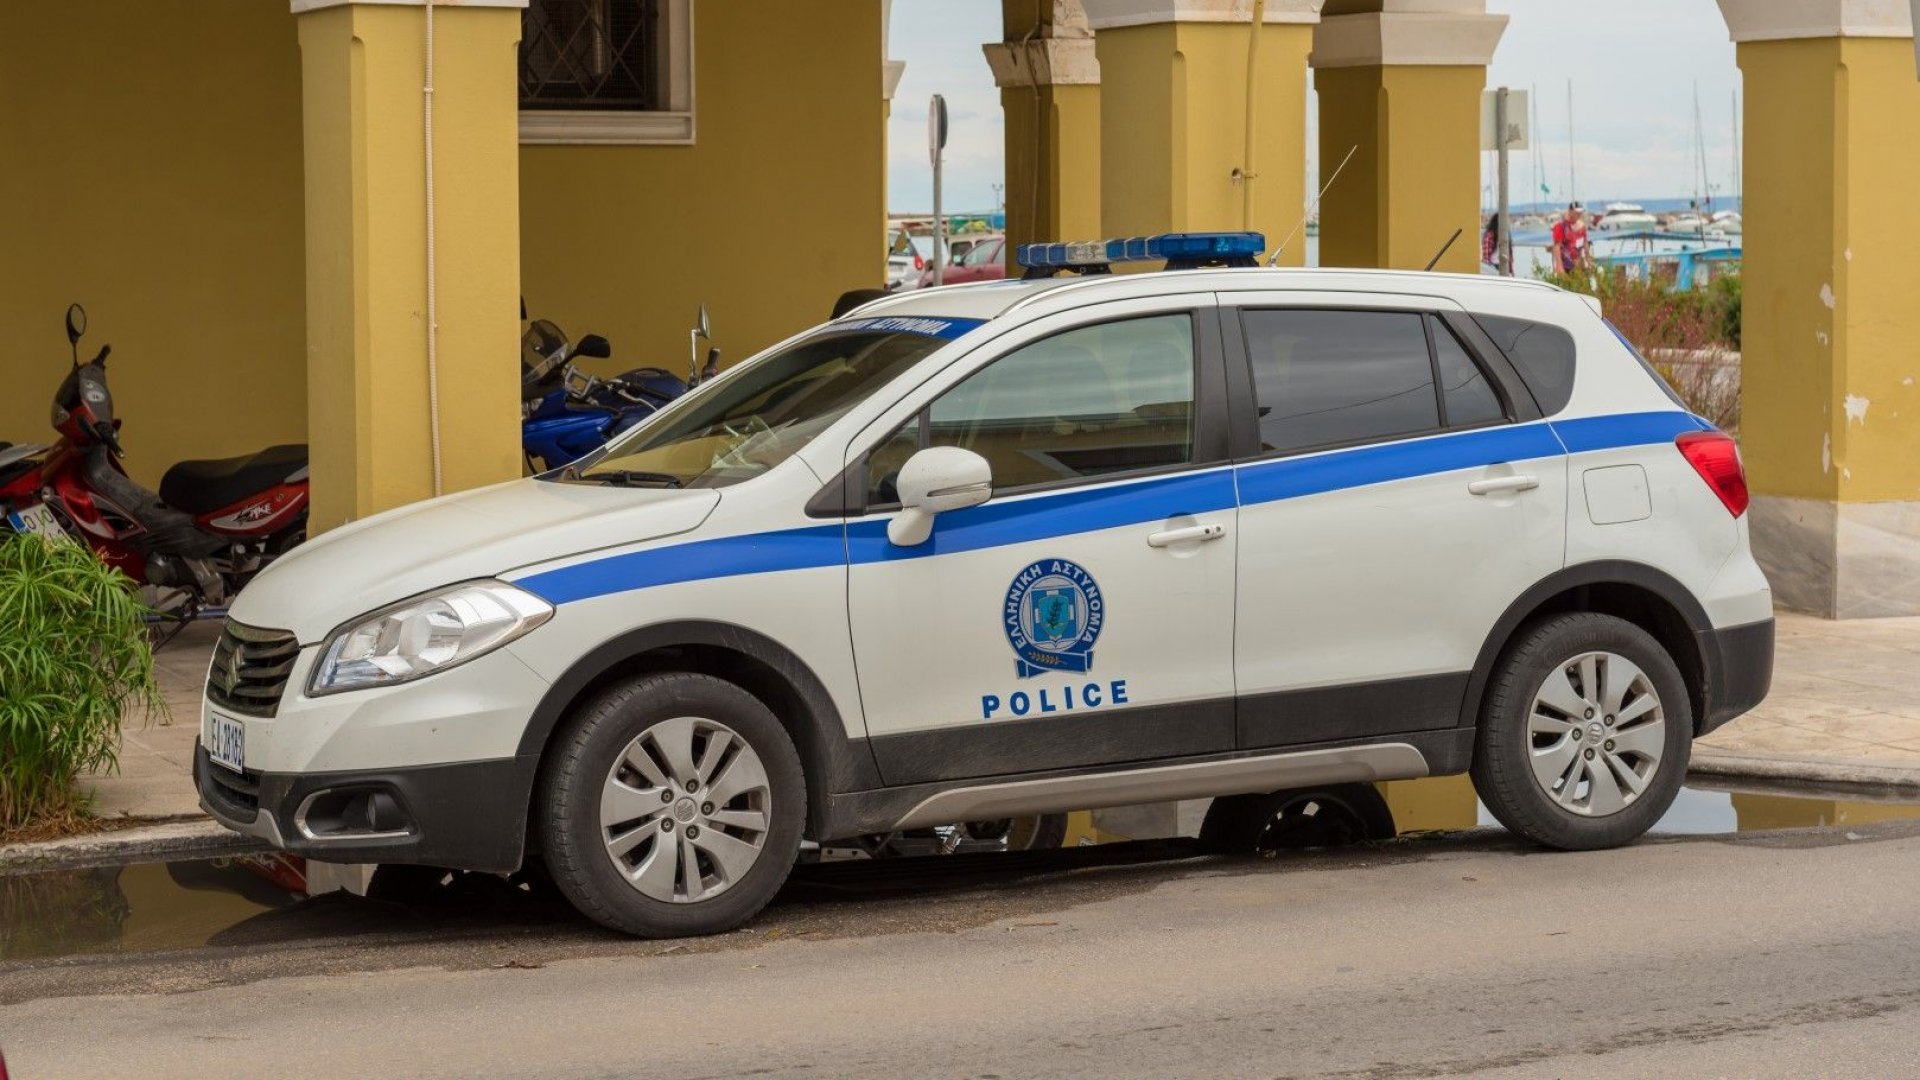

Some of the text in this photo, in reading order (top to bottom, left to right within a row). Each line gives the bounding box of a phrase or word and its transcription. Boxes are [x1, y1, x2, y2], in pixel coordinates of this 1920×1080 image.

[1006, 560, 1101, 650] ΕΛΛΗΝΙΚΗ ΑΣΤΥΝΟΜΙΑ
[982, 680, 1128, 719] POLICE
